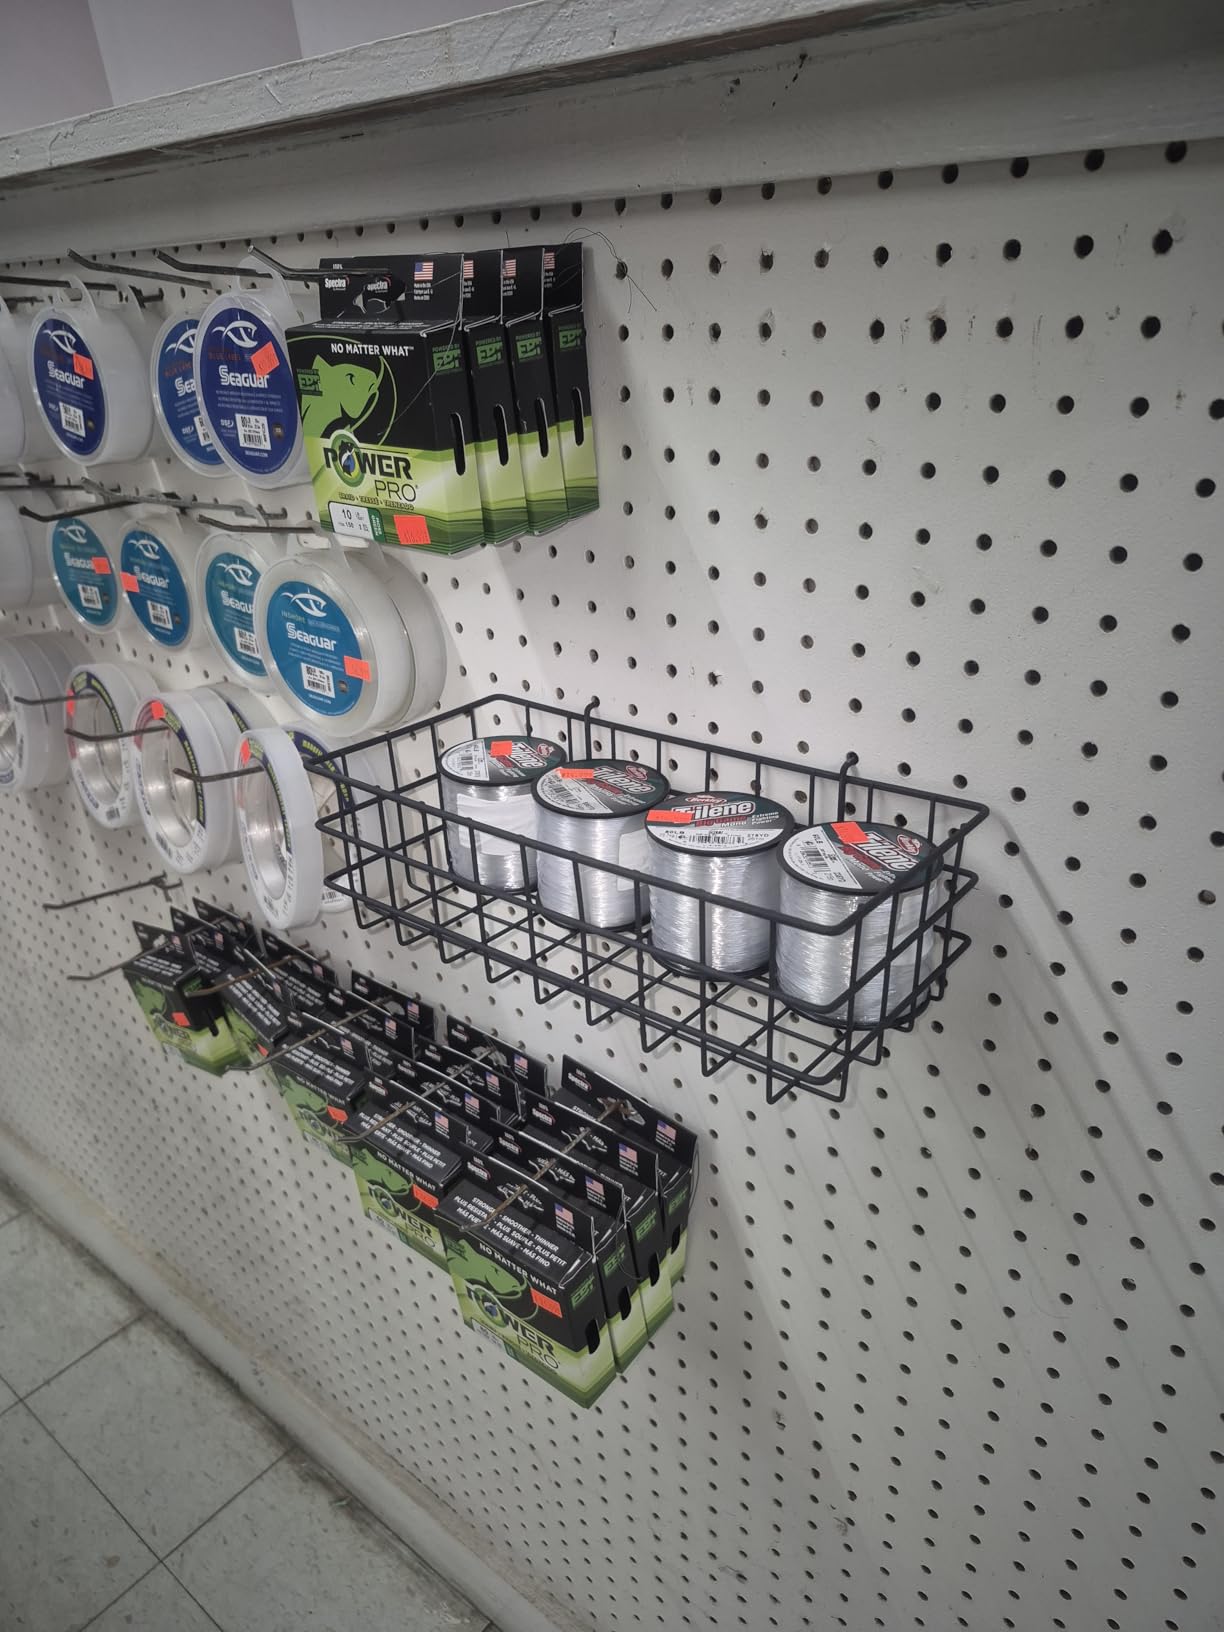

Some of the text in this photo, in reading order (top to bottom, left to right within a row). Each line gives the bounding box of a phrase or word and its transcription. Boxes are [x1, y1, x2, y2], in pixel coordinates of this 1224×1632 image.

[330, 343, 344, 354] NO
[346, 344, 380, 356] MATTER
[48, 360, 86, 390] Seaguar
[218, 365, 270, 389] Seaguar
[323, 447, 413, 481] POWER
[374, 480, 416, 502] PRO
[342, 508, 352, 520] 10
[64, 552, 94, 570] Seagua
[221, 590, 255, 614] Seagu
[286, 622, 336, 652] Seaguar
[388, 1158, 414, 1178] MATTER
[416, 1176, 436, 1192] WHAT
[454, 1196, 568, 1266] PLUS RESISTA PLUS SOUPLE PLUS PETIT
[472, 1198, 496, 1214] STRONG
[502, 1216, 532, 1236] SMOOTHER
[534, 1232, 559, 1252] THINNER
[490, 1228, 504, 1238] MÁS
[503, 1236, 522, 1249] SUAVE
[522, 1248, 536, 1259] MÁS
[535, 1256, 550, 1267] FINO
[480, 1242, 557, 1295] NO MATTER WHAT
